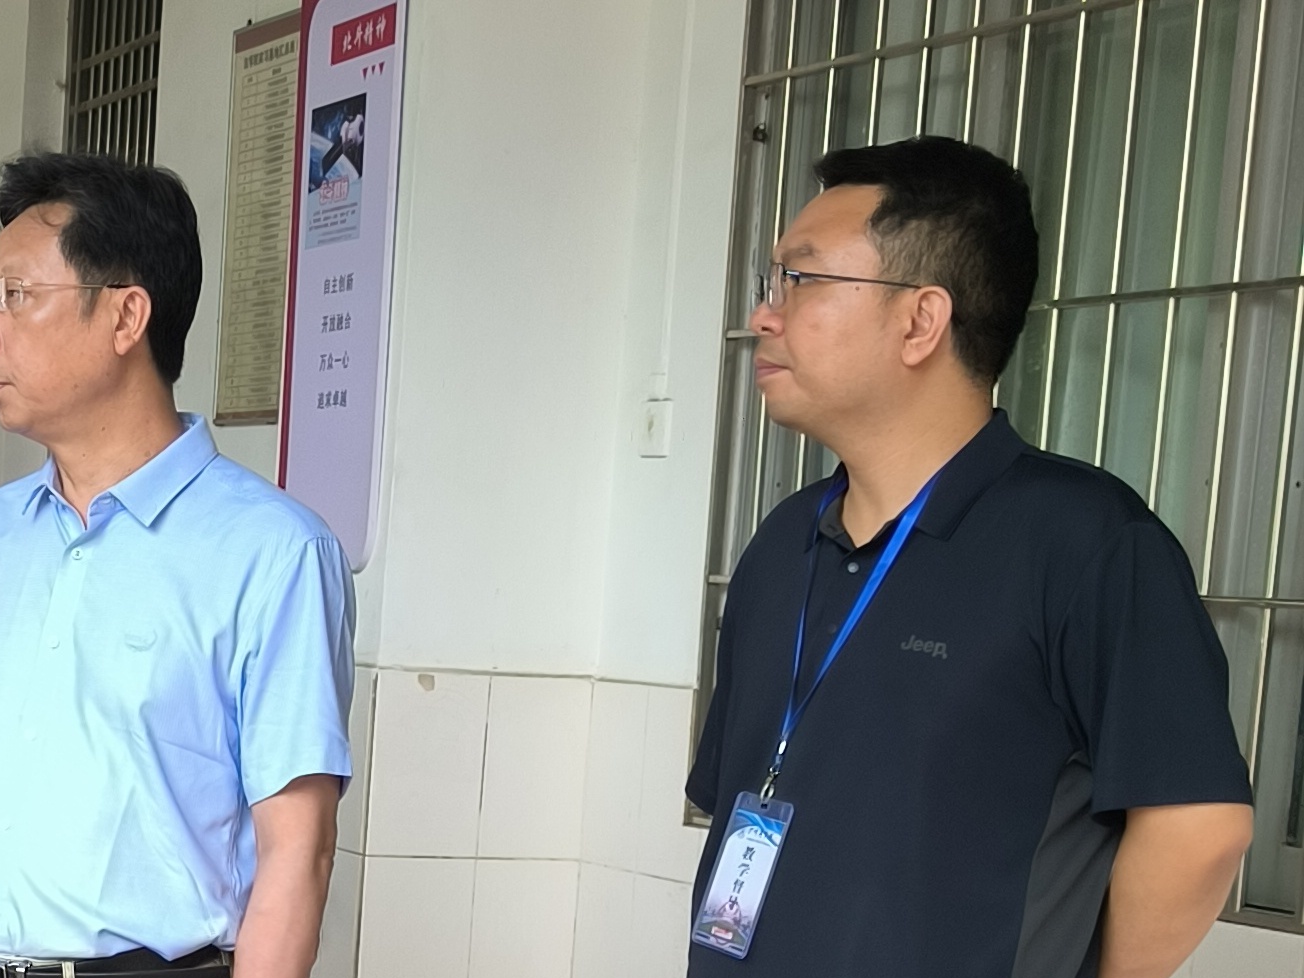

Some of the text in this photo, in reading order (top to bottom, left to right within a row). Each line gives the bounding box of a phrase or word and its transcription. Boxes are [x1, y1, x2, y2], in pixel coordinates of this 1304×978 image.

[323, 272, 355, 295] 自主创新
[321, 312, 352, 333] 开放融合
[319, 351, 350, 372] 万众一心
[317, 389, 348, 409] 追求卓越
[901, 634, 947, 659] Jeep
